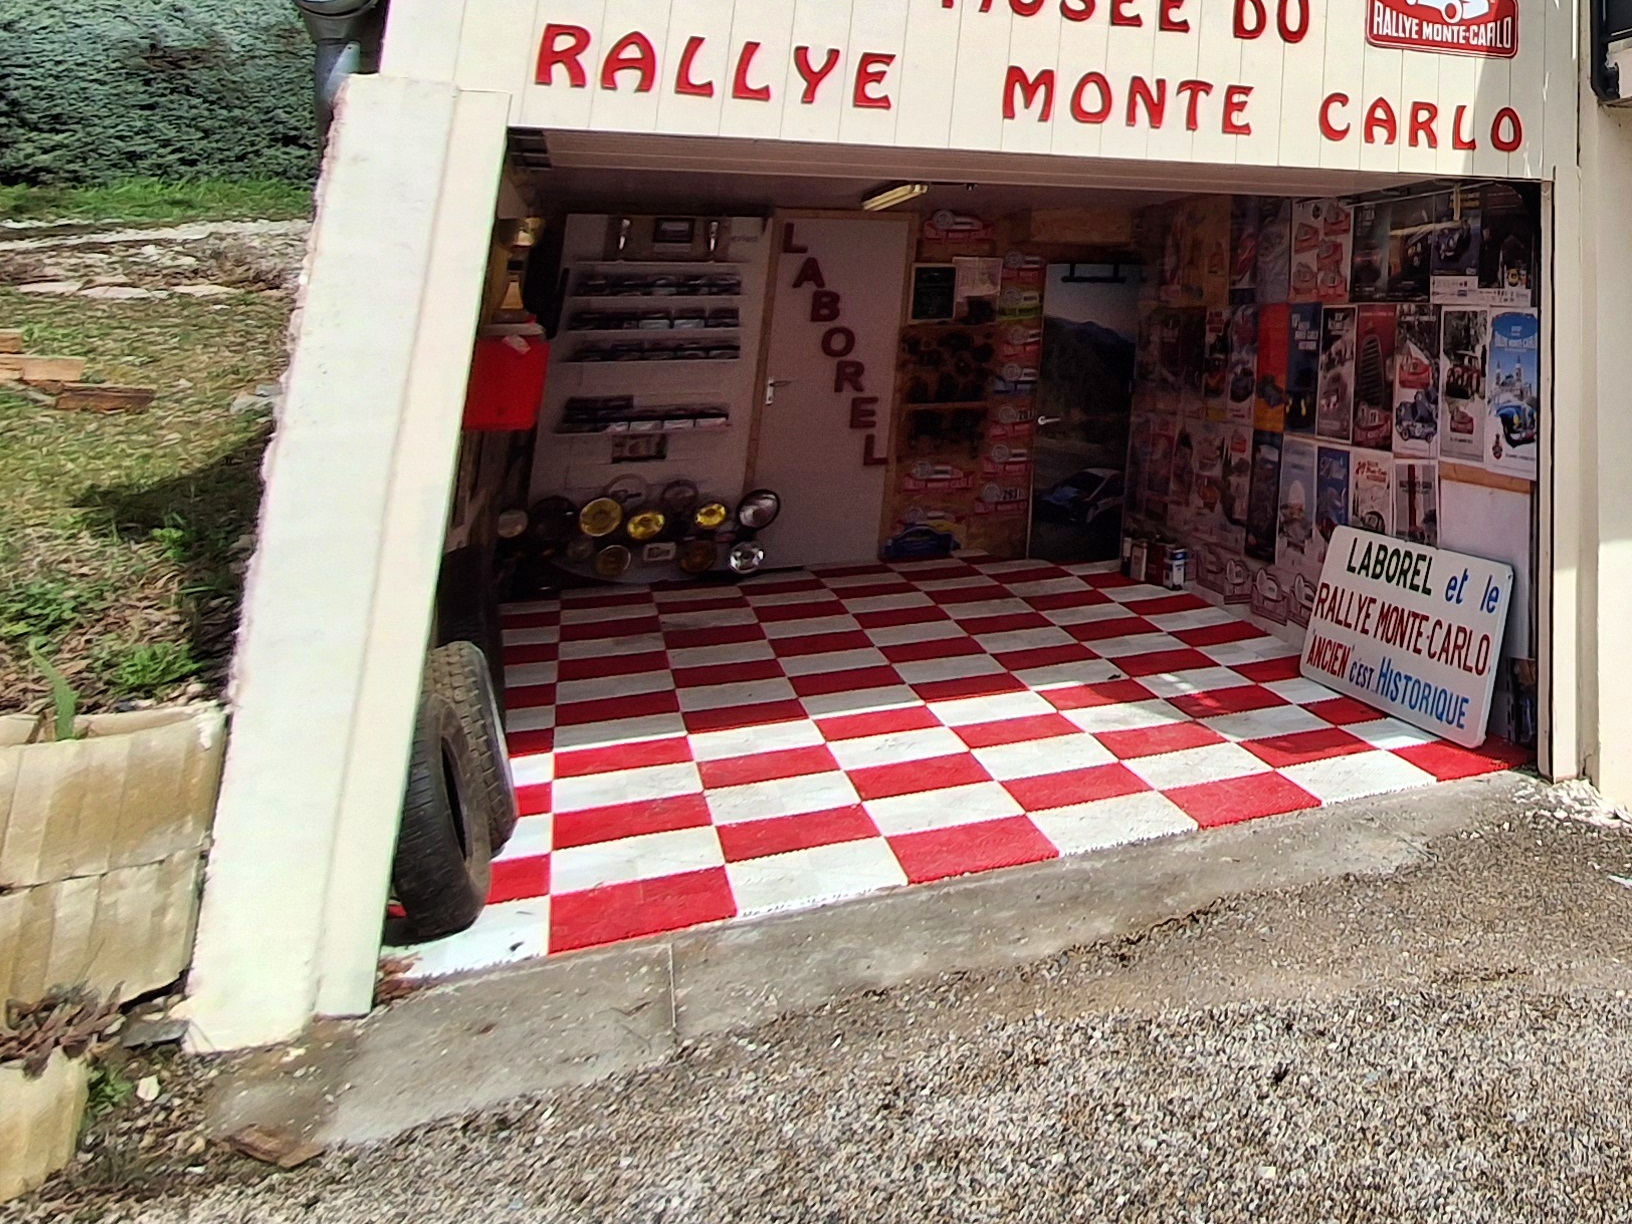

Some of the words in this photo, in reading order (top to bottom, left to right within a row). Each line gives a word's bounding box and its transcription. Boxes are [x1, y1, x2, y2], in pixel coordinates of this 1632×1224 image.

[1373, 0, 1419, 38] RALLYE
[1422, 17, 1512, 48] MONTE-CARLO
[534, 23, 896, 109] RALLYE
[1002, 65, 1254, 136] MONTE
[1318, 92, 1523, 153] CARLO
[782, 221, 889, 466] LABOREL
[1314, 581, 1377, 636] RALLYE
[1346, 536, 1432, 596] LABOREL
[1444, 567, 1470, 605] et
[1480, 573, 1500, 614] le
[1375, 656, 1470, 729] HISTORIQUE
